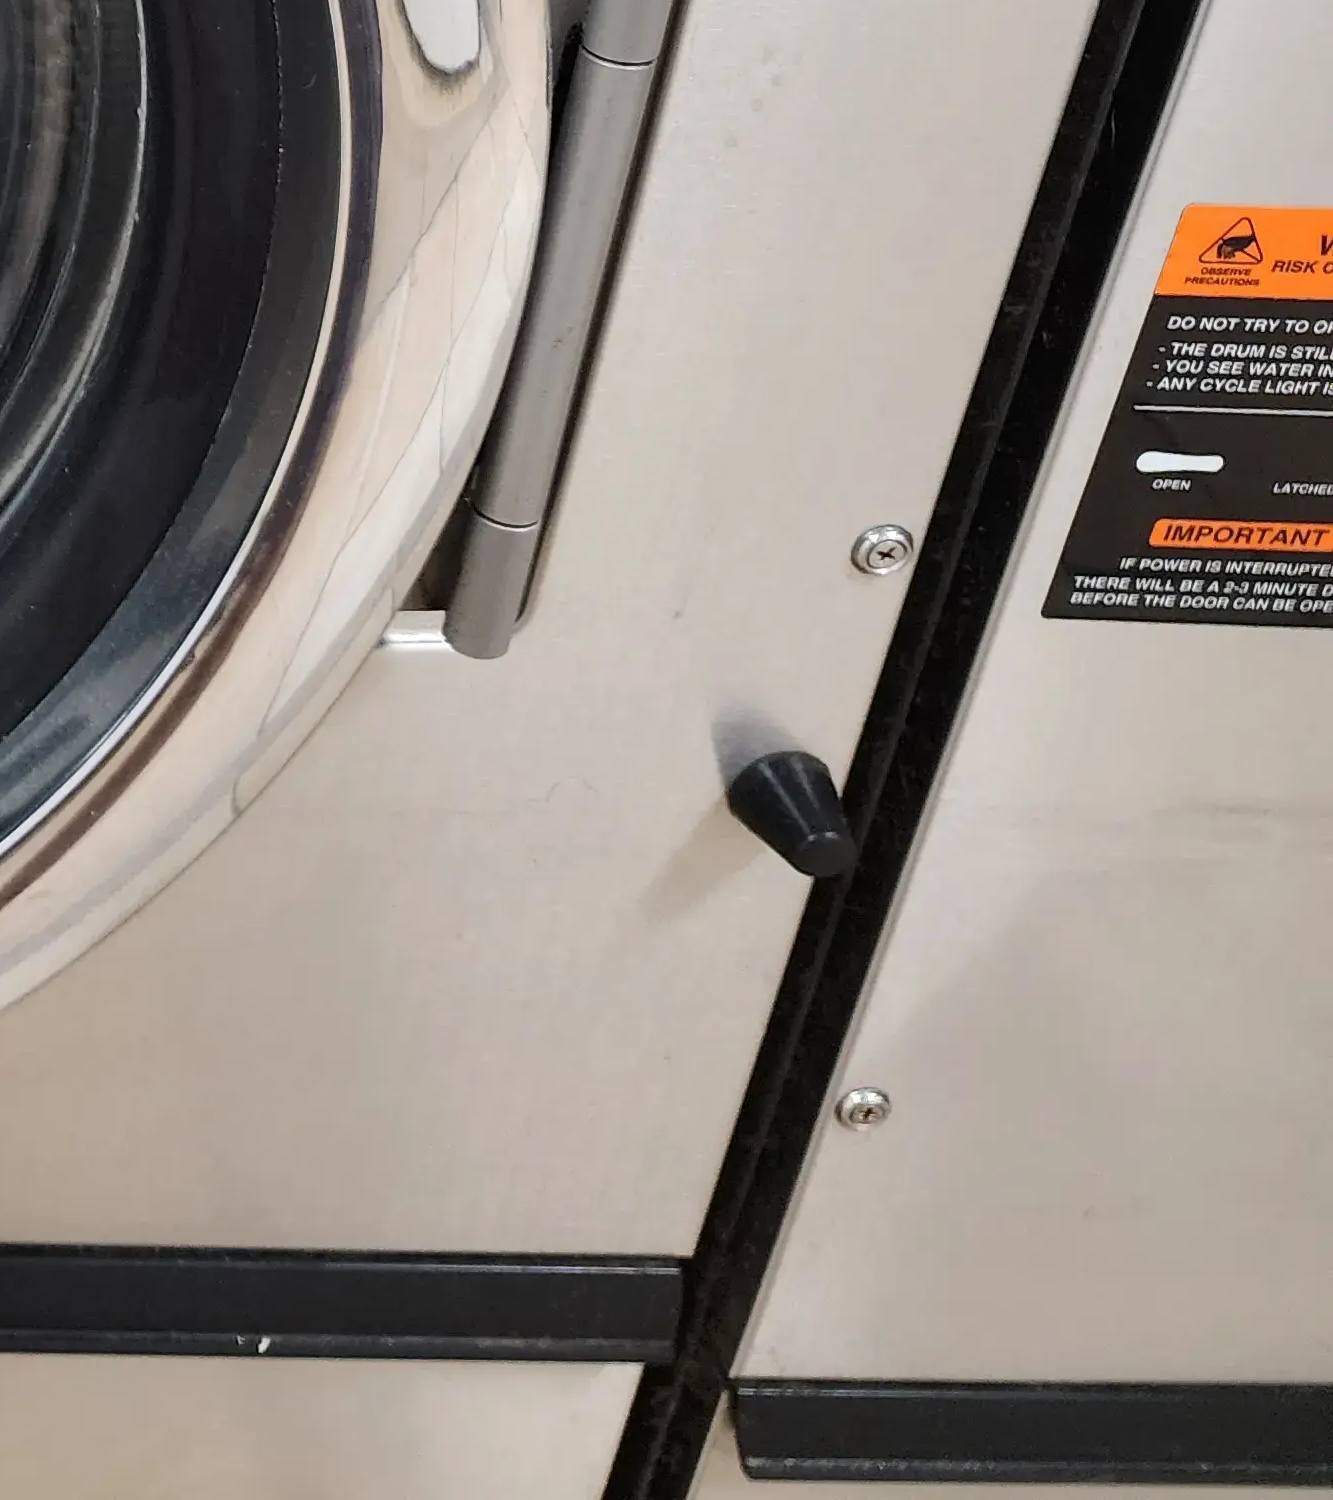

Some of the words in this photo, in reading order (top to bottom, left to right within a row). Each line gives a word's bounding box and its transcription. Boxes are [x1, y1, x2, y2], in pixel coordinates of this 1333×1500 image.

[1201, 267, 1251, 276] OBSERVE
[1271, 259, 1319, 274] RISK
[1184, 276, 1260, 287] PRECAUTIONS
[1167, 316, 1196, 330] DO
[1199, 317, 1241, 331] NOT
[1244, 318, 1281, 333] TRY
[1284, 319, 1310, 333] TO
[1171, 341, 1208, 357] THE
[1211, 344, 1265, 359] DRUM
[1269, 345, 1287, 359] IS
[1290, 346, 1333, 361] STIL
[1165, 359, 1204, 375] YOU
[1207, 361, 1245, 375] SEE
[1249, 361, 1314, 378] WATER
[1156, 376, 1198, 391] ANY
[1199, 378, 1262, 393] CYCLE
[1264, 379, 1321, 395] LIGHT
[1152, 478, 1192, 491] OPEN
[1163, 523, 1330, 546] IMPORTANT
[1119, 557, 1137, 570] IF
[1139, 558, 1203, 572] POWER
[1205, 560, 1222, 573] IS
[1225, 560, 1333, 577] INTERRUPTE
[1074, 575, 1132, 590] THERE
[1135, 577, 1175, 592] WILL
[1180, 579, 1205, 593] BE
[1207, 581, 1219, 593] A
[1224, 581, 1249, 594] 2-3
[1253, 582, 1319, 597] MINUTE
[1070, 592, 1142, 606] BEFORE
[1144, 594, 1177, 607] THE
[1180, 596, 1229, 610] DOOR
[1233, 597, 1270, 611] CAN
[1272, 599, 1298, 612] BE
